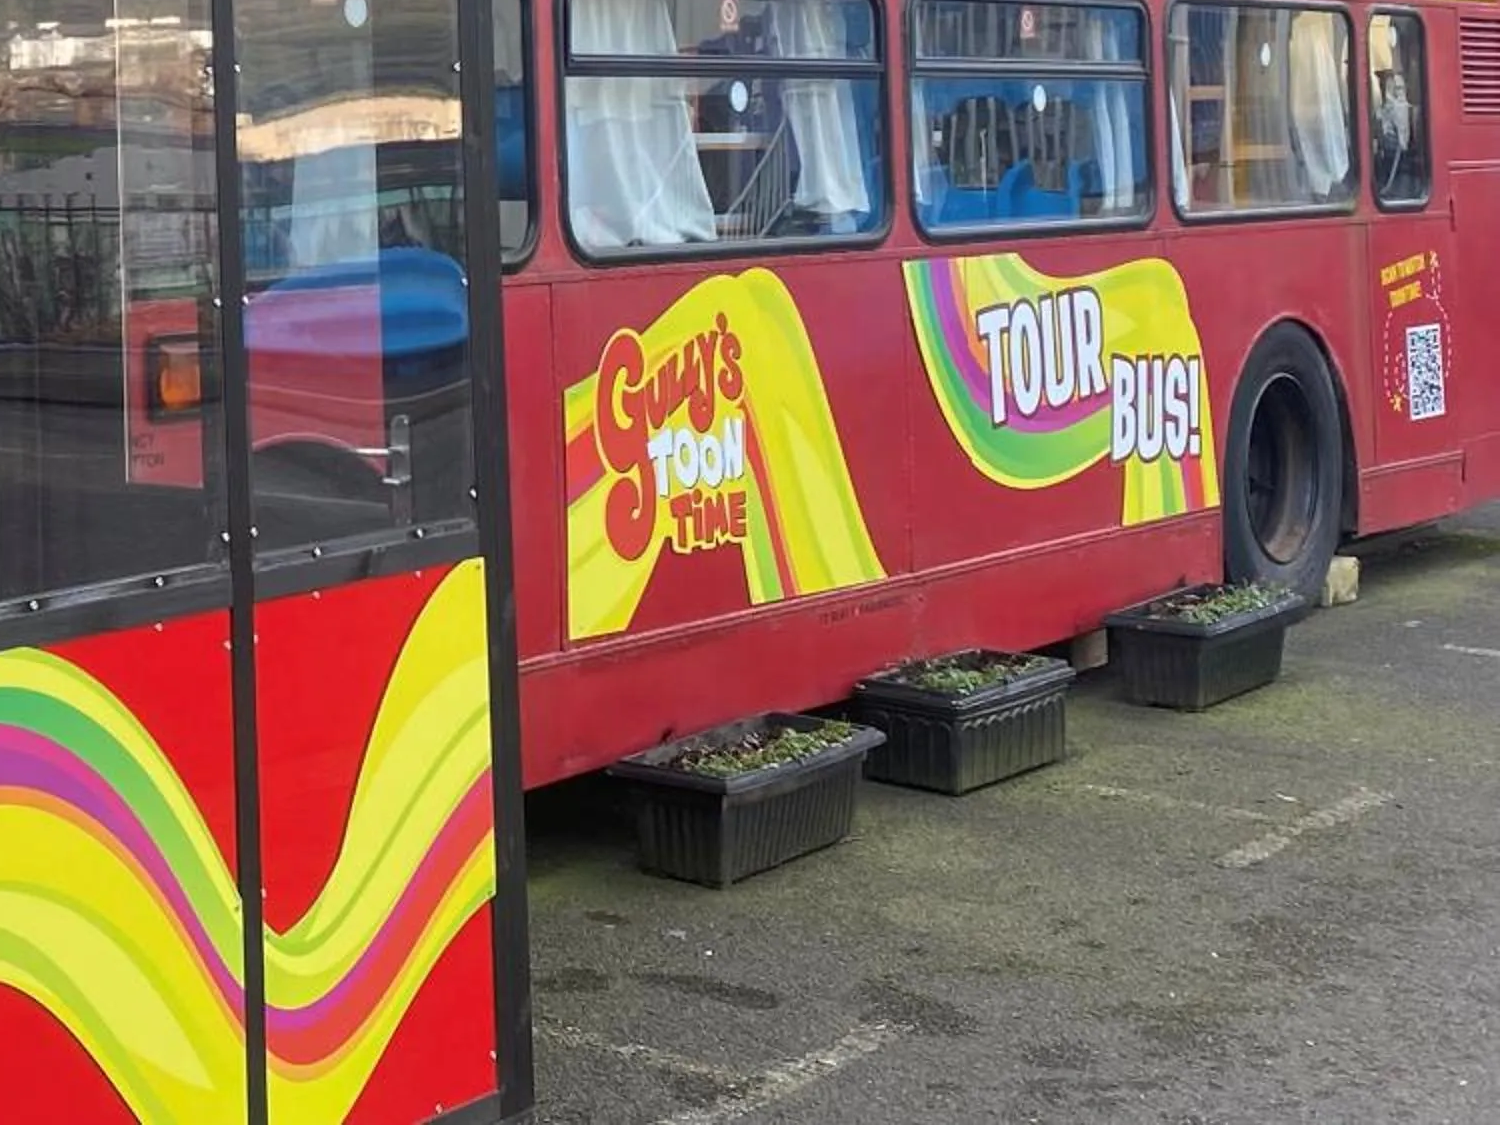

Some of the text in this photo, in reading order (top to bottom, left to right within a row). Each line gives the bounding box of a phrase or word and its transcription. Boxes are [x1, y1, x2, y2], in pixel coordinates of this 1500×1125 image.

[596, 311, 746, 563] GULLY'S
[647, 415, 746, 499] TOON
[975, 284, 1202, 465] TOUR BUS!
